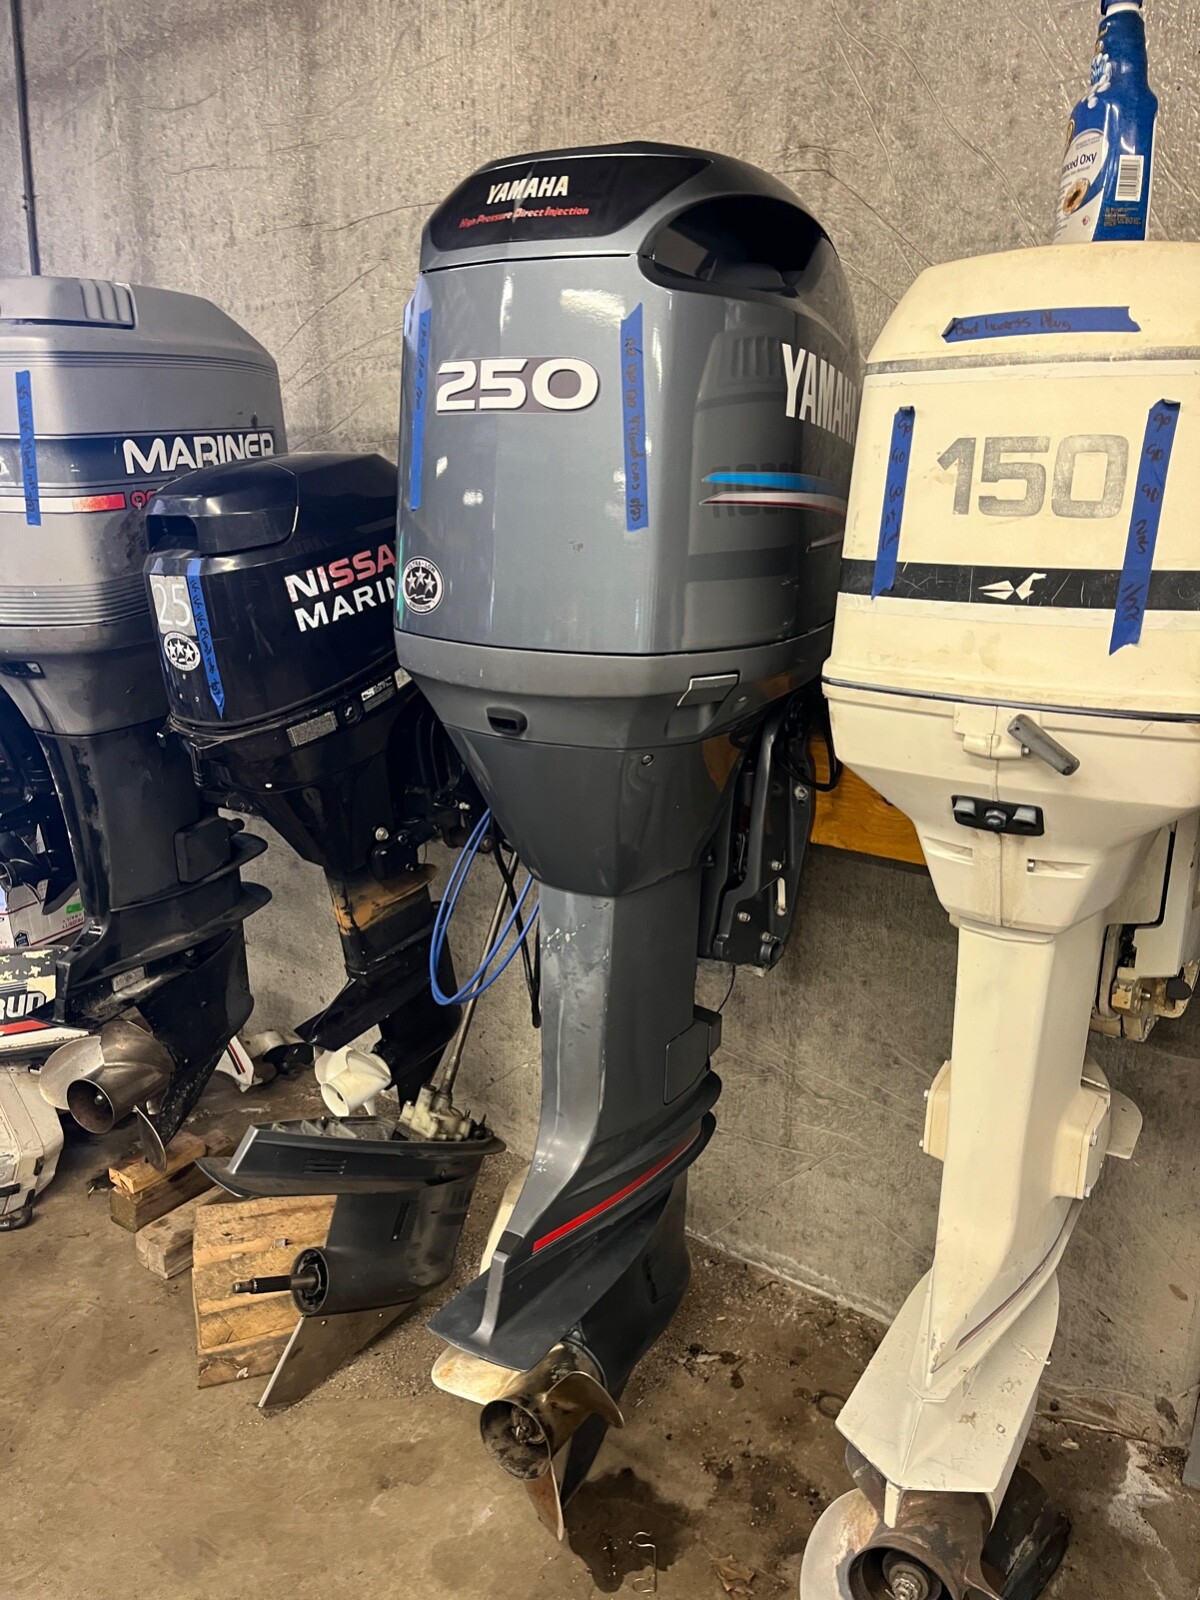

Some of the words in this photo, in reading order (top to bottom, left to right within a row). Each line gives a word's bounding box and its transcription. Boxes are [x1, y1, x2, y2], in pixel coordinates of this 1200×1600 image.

[1079, 152, 1098, 165] Oxy
[486, 175, 569, 205] YAMAHA
[459, 217, 477, 229] High
[476, 211, 513, 224] Pressure
[513, 207, 545, 219] Direct
[544, 206, 590, 218] Injection
[436, 359, 599, 411] 250
[122, 432, 275, 474] MARINER
[936, 434, 1130, 519] 150
[284, 543, 397, 603] NISSA
[153, 583, 191, 627] 25
